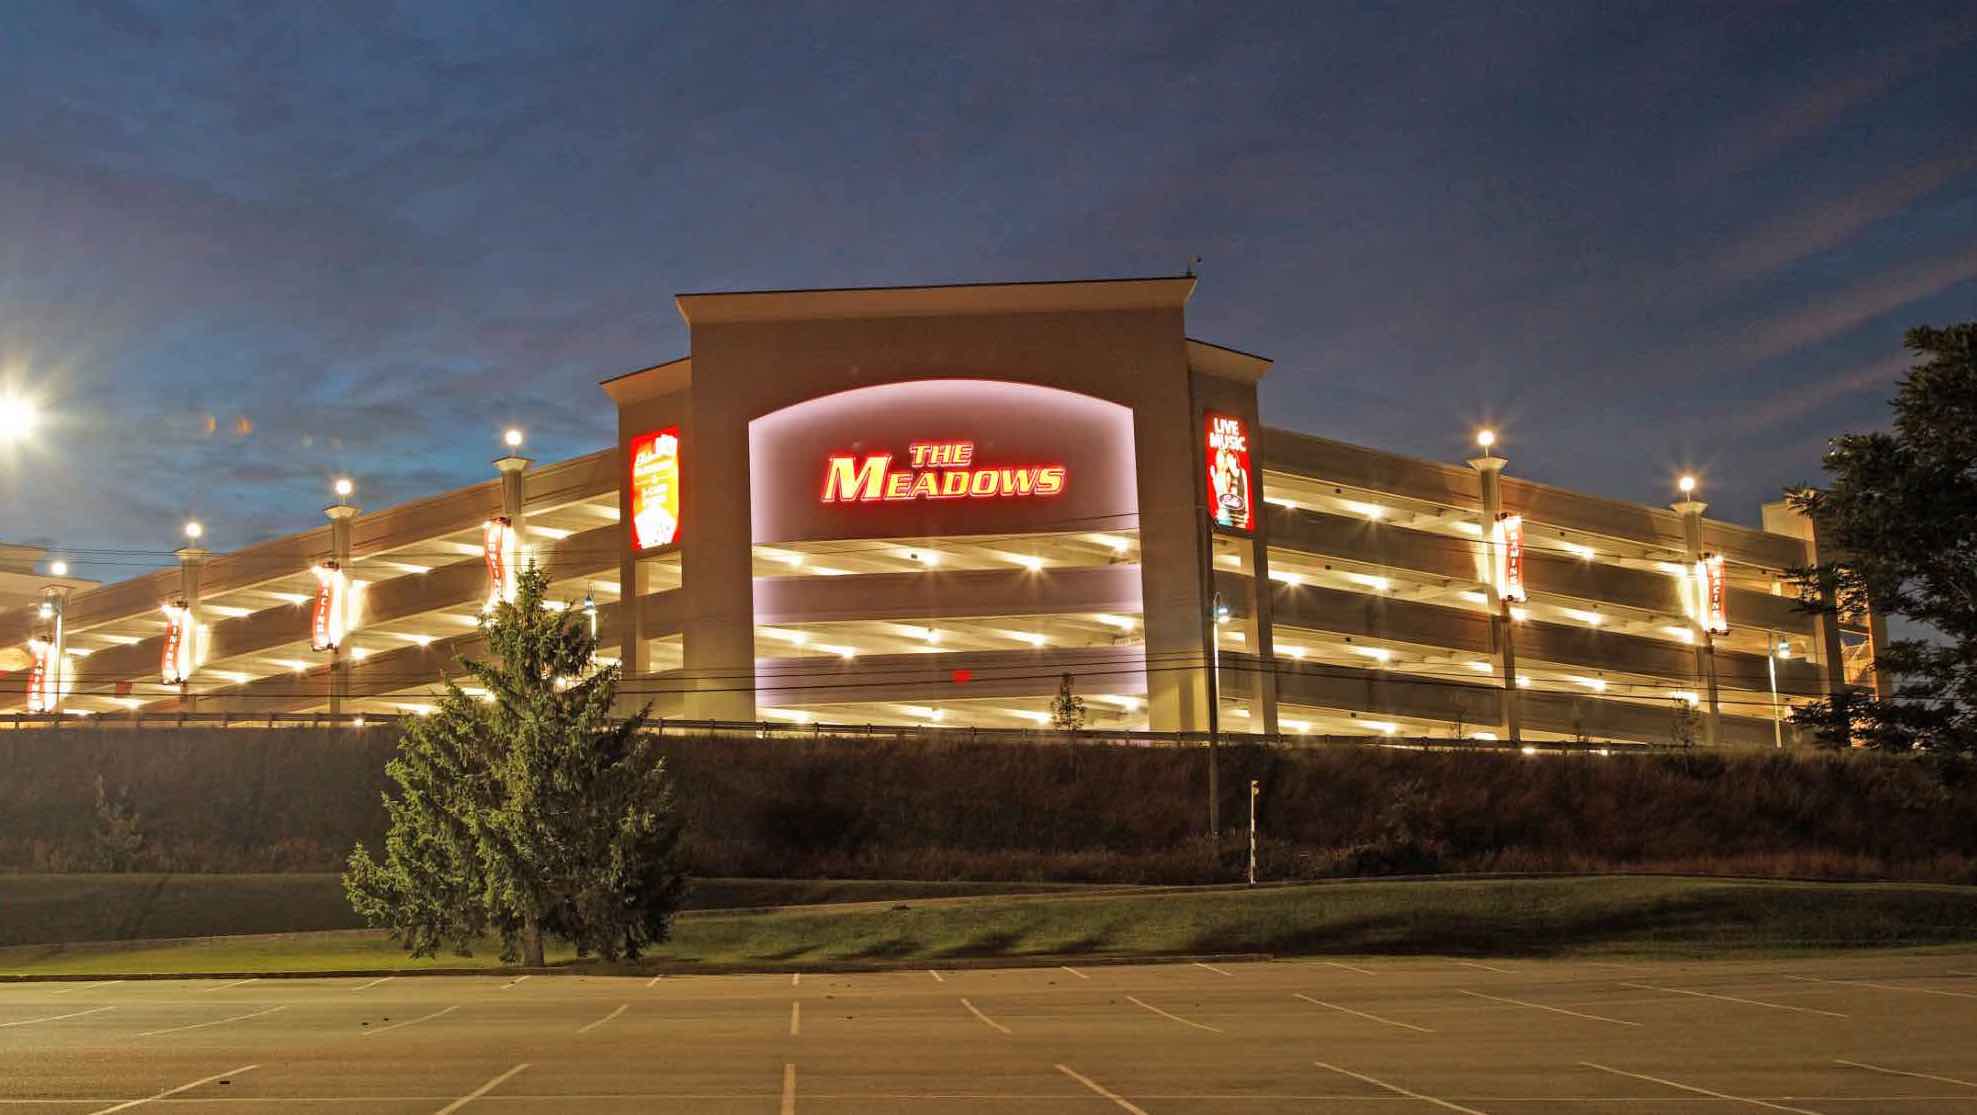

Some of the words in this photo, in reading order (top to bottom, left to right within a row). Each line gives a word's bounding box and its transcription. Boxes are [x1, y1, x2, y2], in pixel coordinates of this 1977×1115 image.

[1213, 417, 1239, 436] LIVE
[1209, 432, 1247, 452] MUSIC
[908, 443, 975, 468] THE
[822, 455, 1066, 503] MEADOWS
